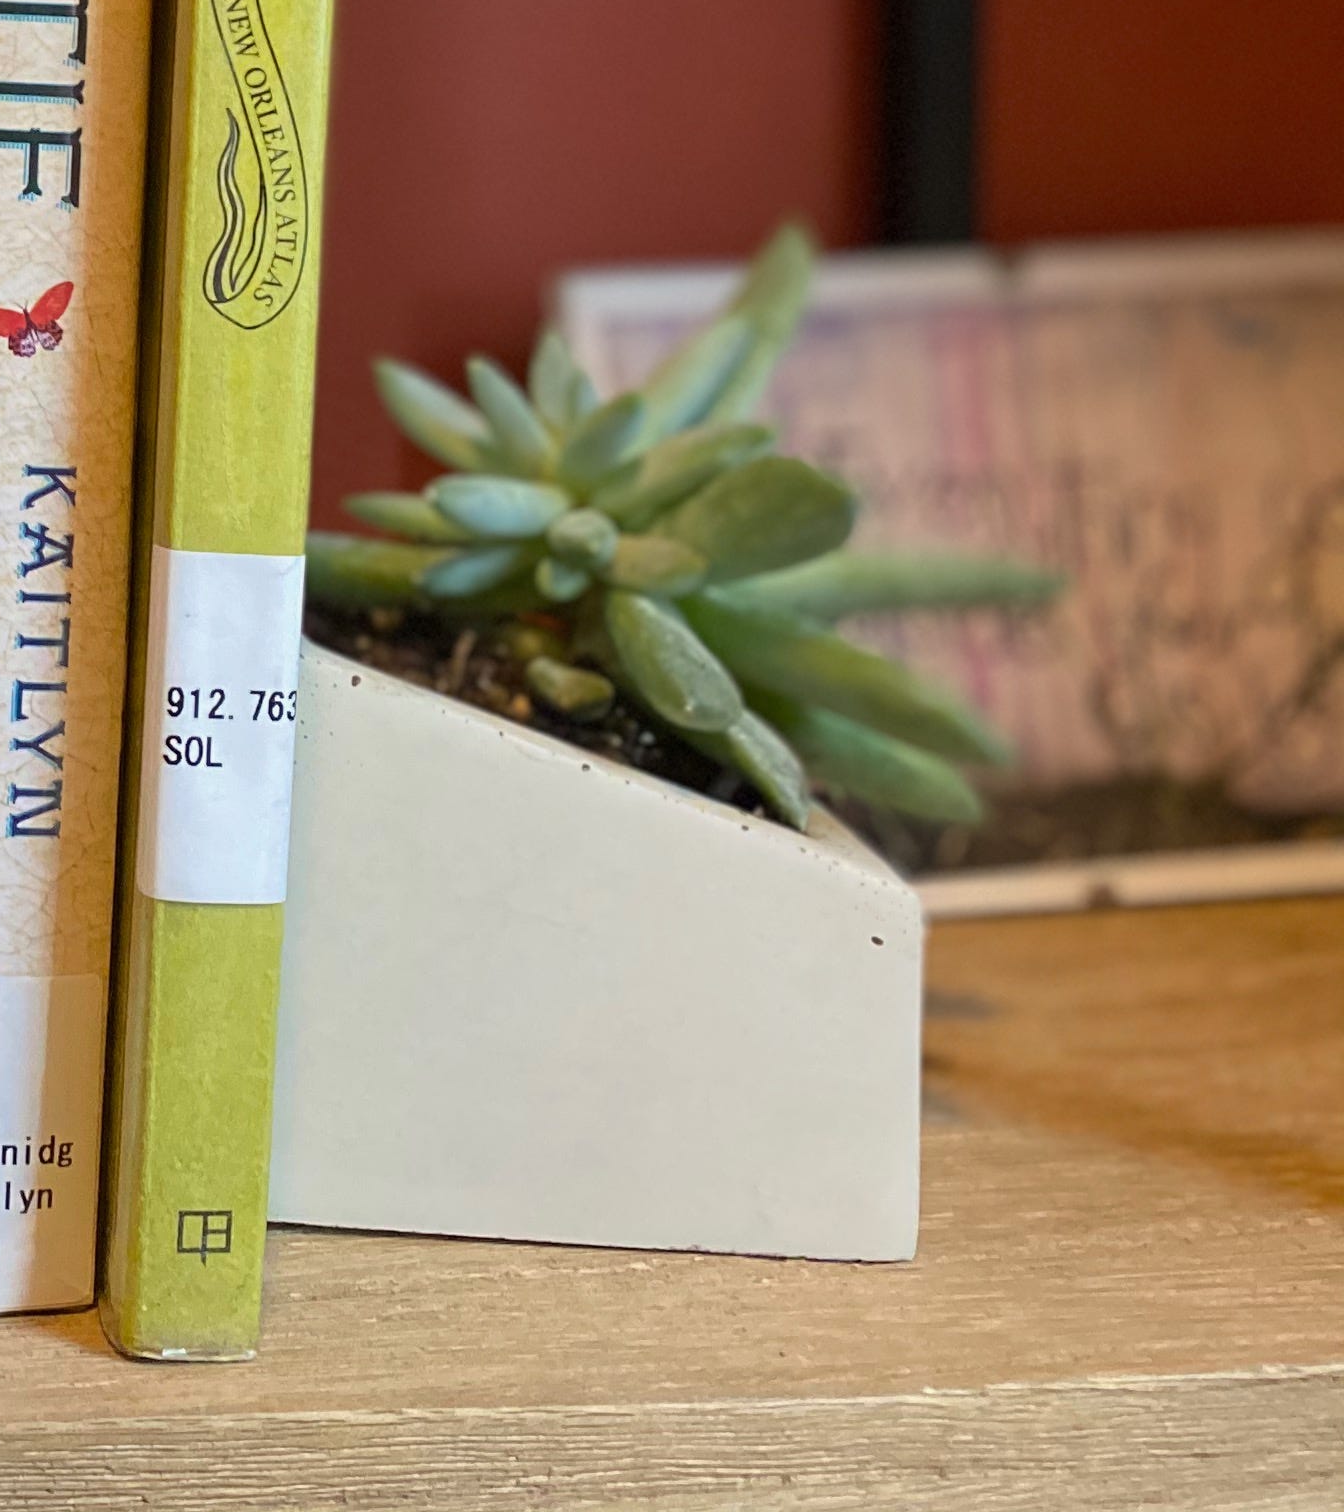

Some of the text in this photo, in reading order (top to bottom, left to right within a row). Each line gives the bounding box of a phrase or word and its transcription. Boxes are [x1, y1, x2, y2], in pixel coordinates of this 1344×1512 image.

[246, 67, 296, 202] ORLEANS
[254, 212, 297, 307] ATLAS
[6, 463, 77, 838] KAITLYN
[162, 735, 223, 768] SOL
